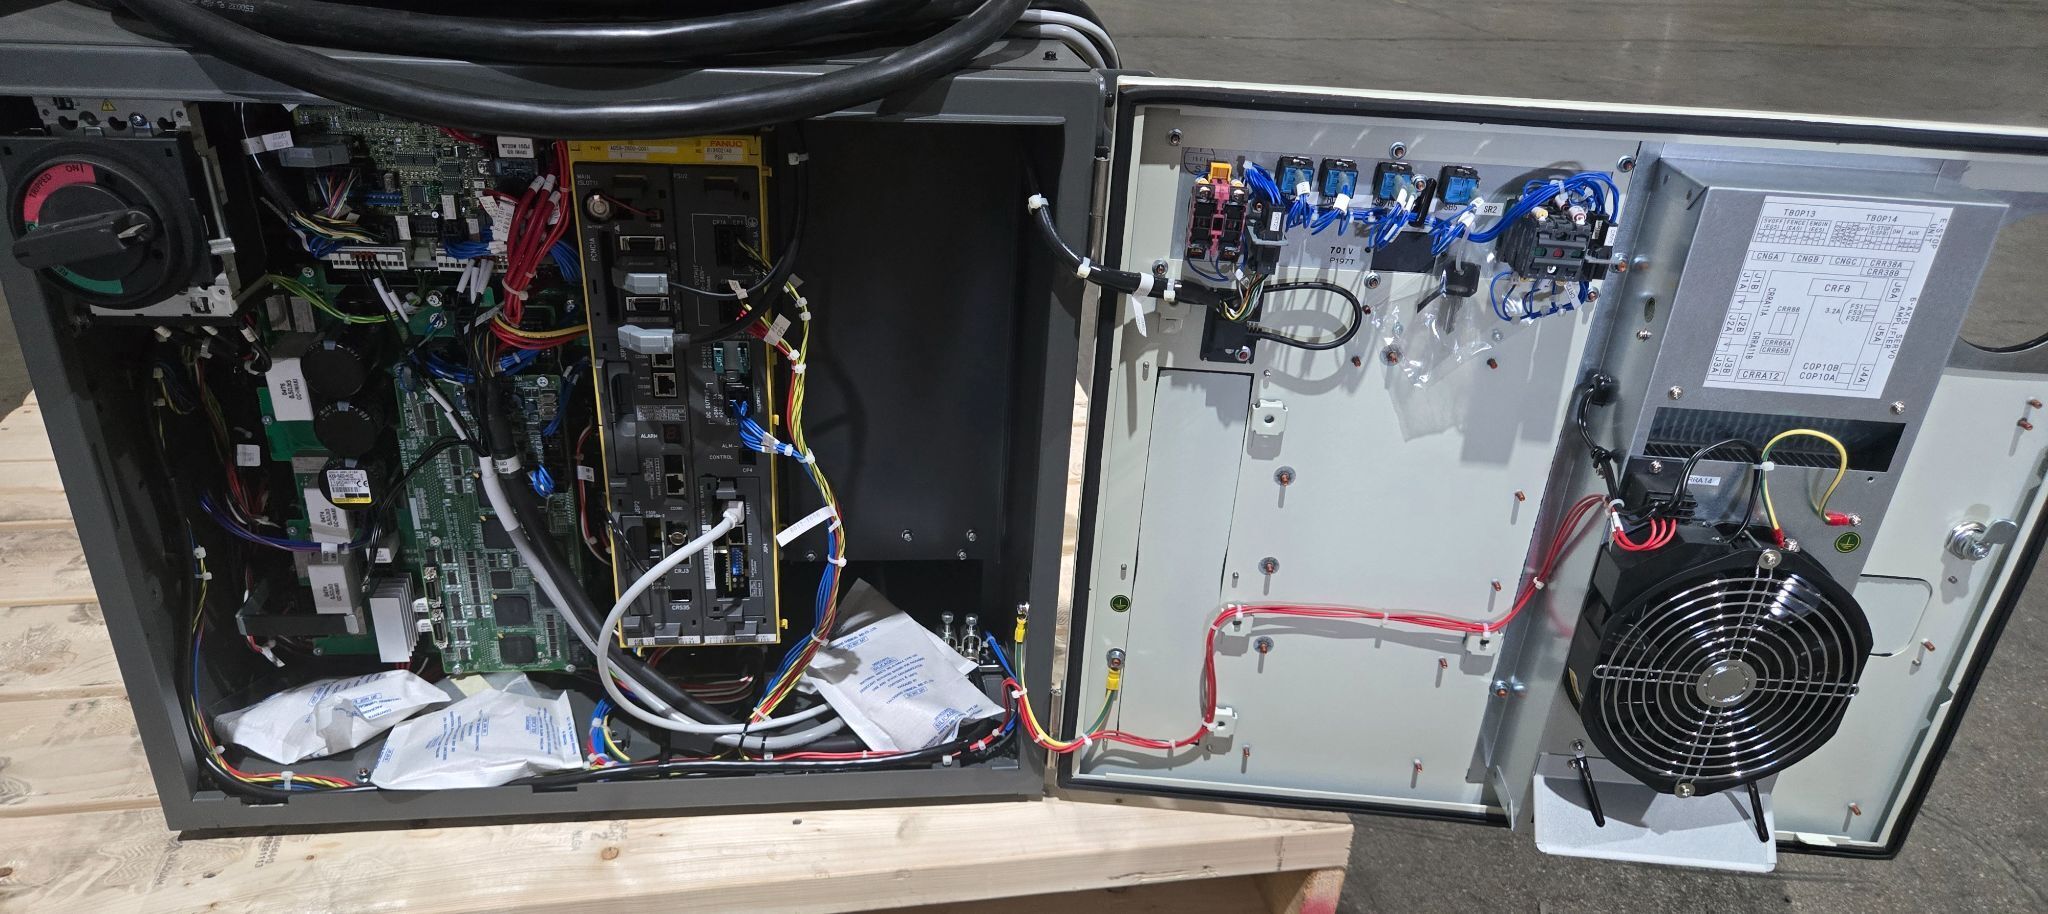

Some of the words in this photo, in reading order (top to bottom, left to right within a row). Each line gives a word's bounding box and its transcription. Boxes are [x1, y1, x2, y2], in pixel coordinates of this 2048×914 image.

[29, 173, 52, 199] TRIPPED
[1484, 206, 1498, 214] SR2
[1927, 224, 1938, 243] UNIT
[1931, 218, 1948, 249] E-STOP
[1756, 252, 1779, 260] CNGA
[1796, 254, 1819, 262] CNGB
[1834, 258, 1857, 266] CNGC
[1870, 260, 1902, 268] CRR38A
[1824, 284, 1850, 293] CRF8
[1890, 282, 1902, 299] J6A
[1724, 314, 1736, 332] J2A
[1736, 316, 1748, 332] J2B
[1884, 306, 1905, 349] AMPLIFIER
[1873, 325, 1885, 342] J5A
[1888, 334, 1902, 360] SERVO
[1711, 356, 1722, 374] J3A
[1722, 357, 1733, 374] J3B
[1803, 362, 1839, 372] COP10B
[1742, 370, 1780, 380] CRRA12
[1800, 372, 1835, 381] COP10A
[1858, 366, 1871, 384] J4A
